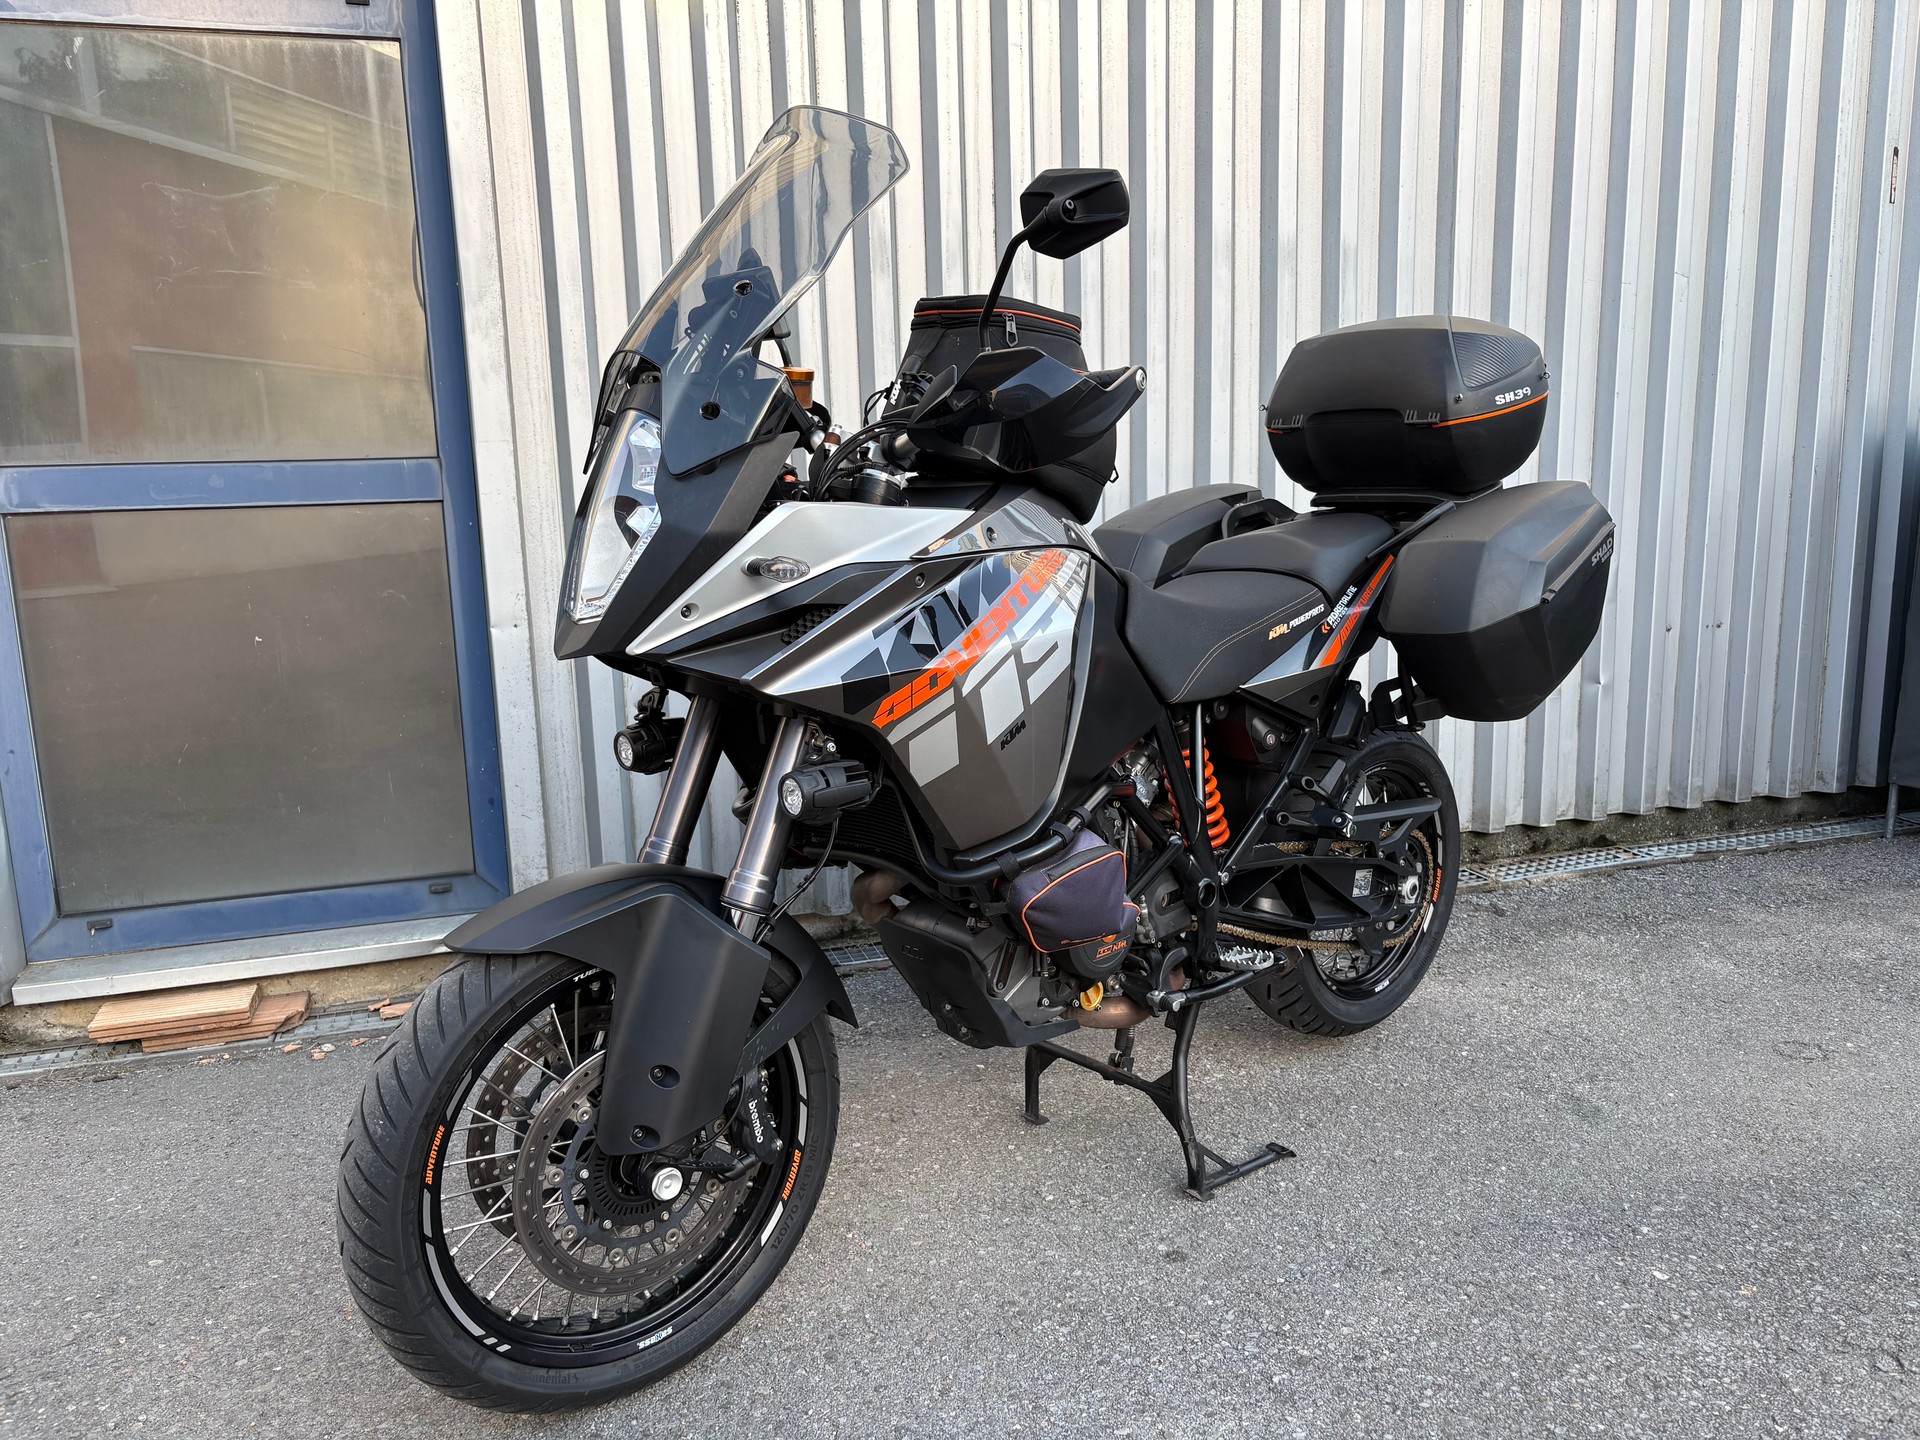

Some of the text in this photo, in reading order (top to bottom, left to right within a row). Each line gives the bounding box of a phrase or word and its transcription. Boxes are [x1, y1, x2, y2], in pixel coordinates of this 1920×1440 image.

[1494, 386, 1532, 406] SH39
[1591, 537, 1613, 567] SHAD
[1327, 585, 1358, 626] ADRENALINE
[1340, 586, 1374, 648] ADVENTURE
[871, 548, 1066, 729] ADVENTURE
[1268, 623, 1289, 640] KTM
[1000, 719, 1027, 751] KTM
[748, 1098, 764, 1144] brembo
[425, 1124, 446, 1185] ADVENTURE
[782, 1149, 802, 1201] ADVENTURE
[770, 1203, 799, 1251] 120/70
[796, 1181, 809, 1200] ZR
[804, 1163, 813, 1178] 19
